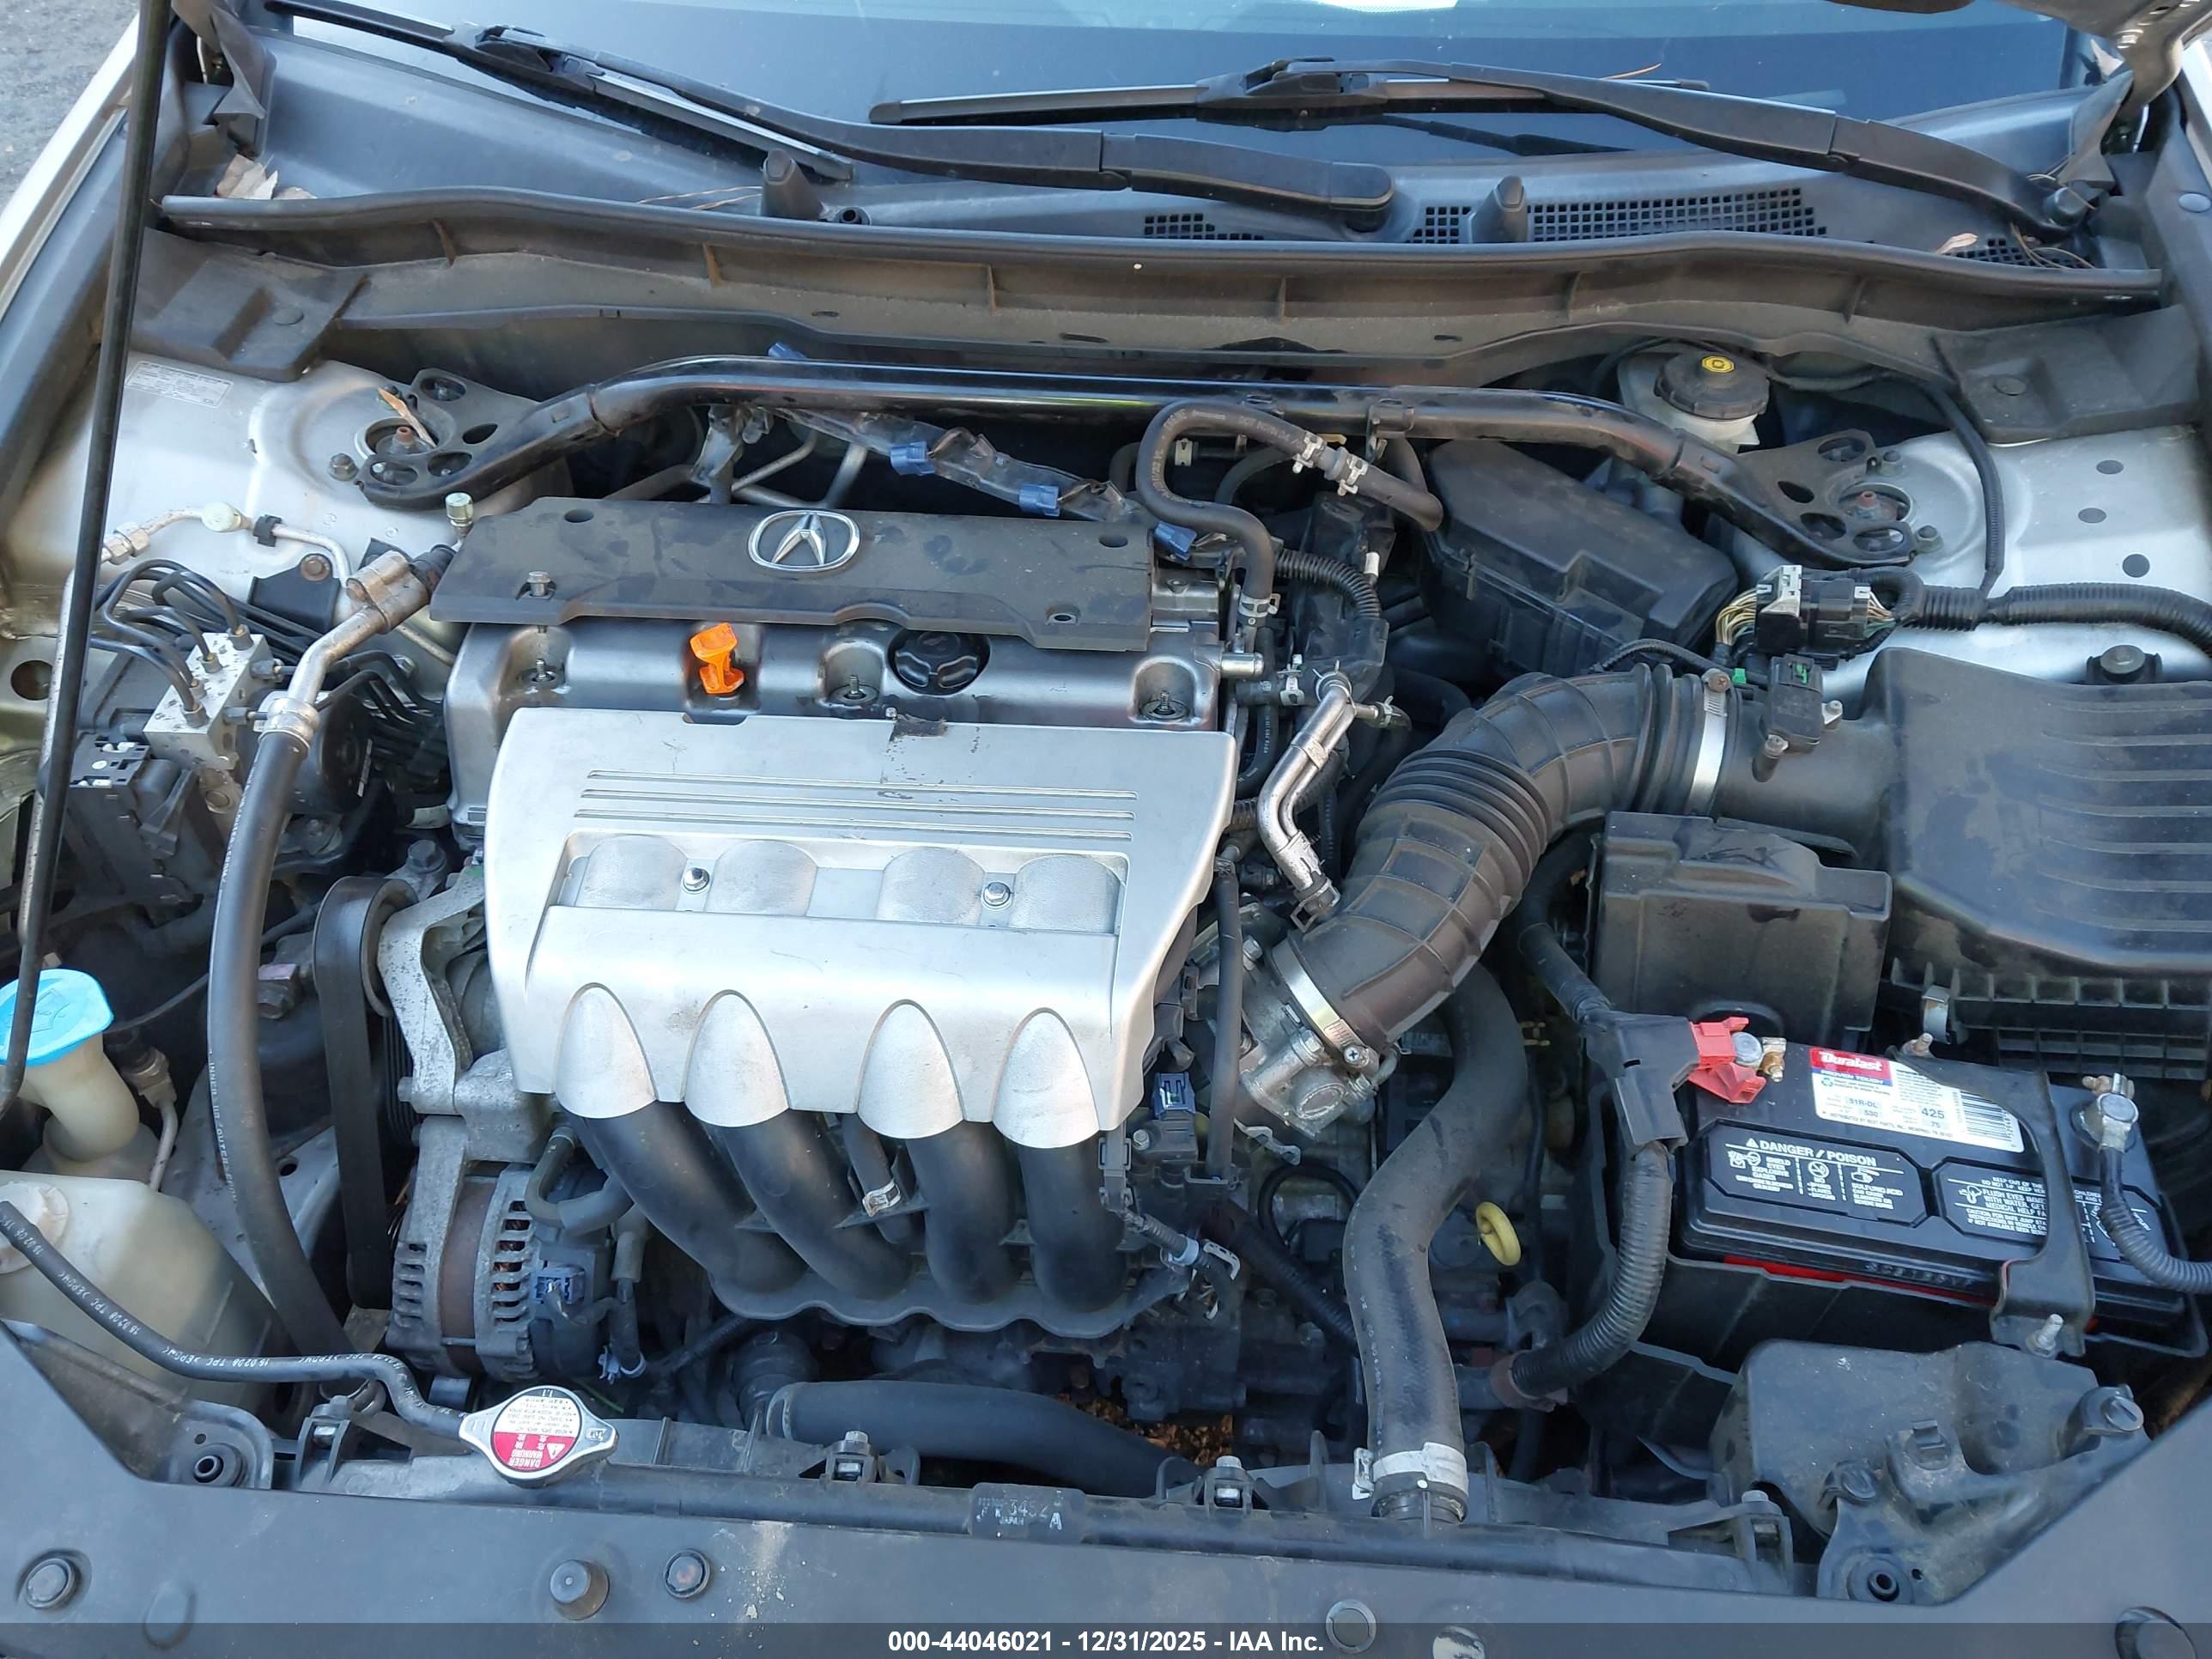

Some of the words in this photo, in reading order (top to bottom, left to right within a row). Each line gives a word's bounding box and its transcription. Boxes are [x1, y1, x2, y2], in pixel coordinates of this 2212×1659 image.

[1819, 1051, 1882, 1072] Duralast
[1921, 1108, 1945, 1120] 425
[1759, 1140, 1814, 1157] DANGER
[1827, 1151, 1876, 1166] POISON
[1982, 1188, 2005, 1198] FLUSH
[2007, 1193, 2024, 1201] EYES
[1985, 1202, 2015, 1212] MEDICAL
[511, 1449, 544, 1459] WARNING
[508, 1458, 542, 1468] DANGER
